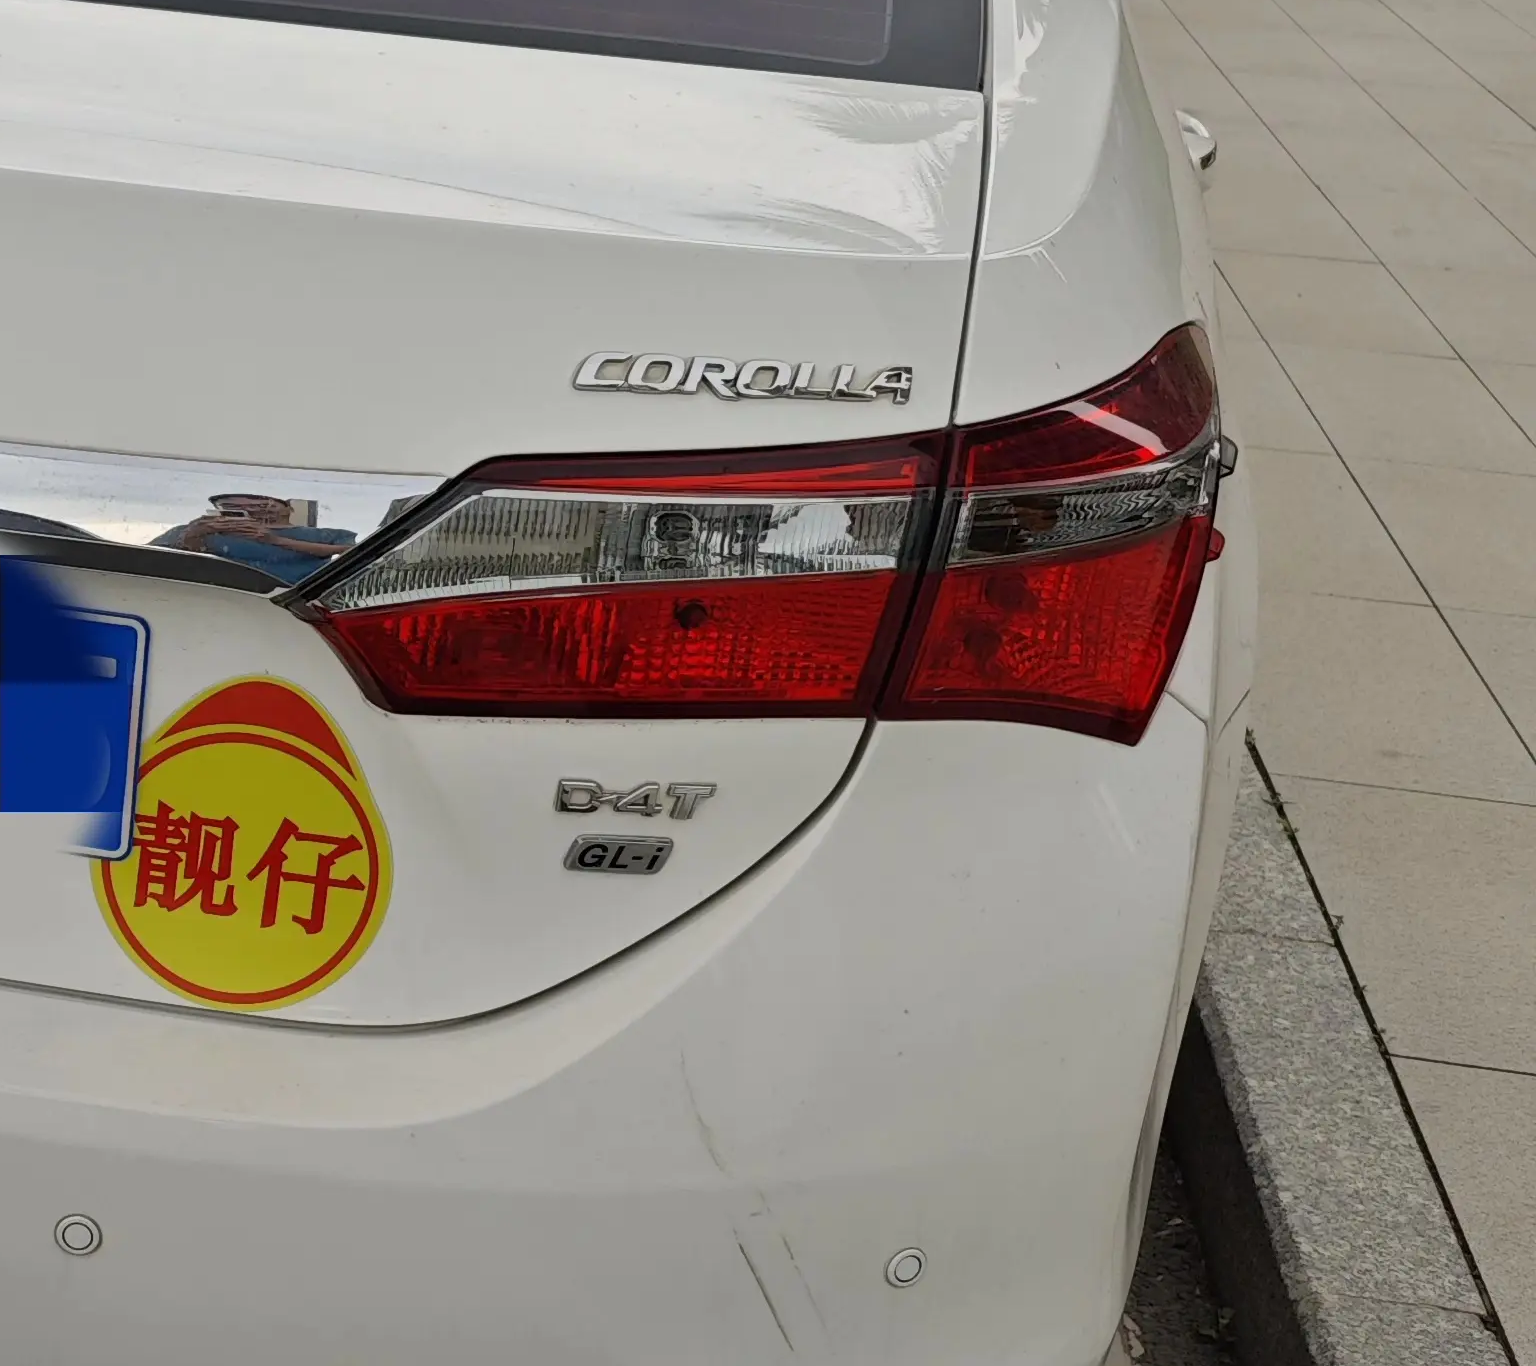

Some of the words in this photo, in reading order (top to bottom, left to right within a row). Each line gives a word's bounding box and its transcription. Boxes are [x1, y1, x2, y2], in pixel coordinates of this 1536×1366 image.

[572, 351, 914, 405] COROLLA
[133, 799, 366, 934] 靓仔
[577, 843, 665, 871] GL-i
